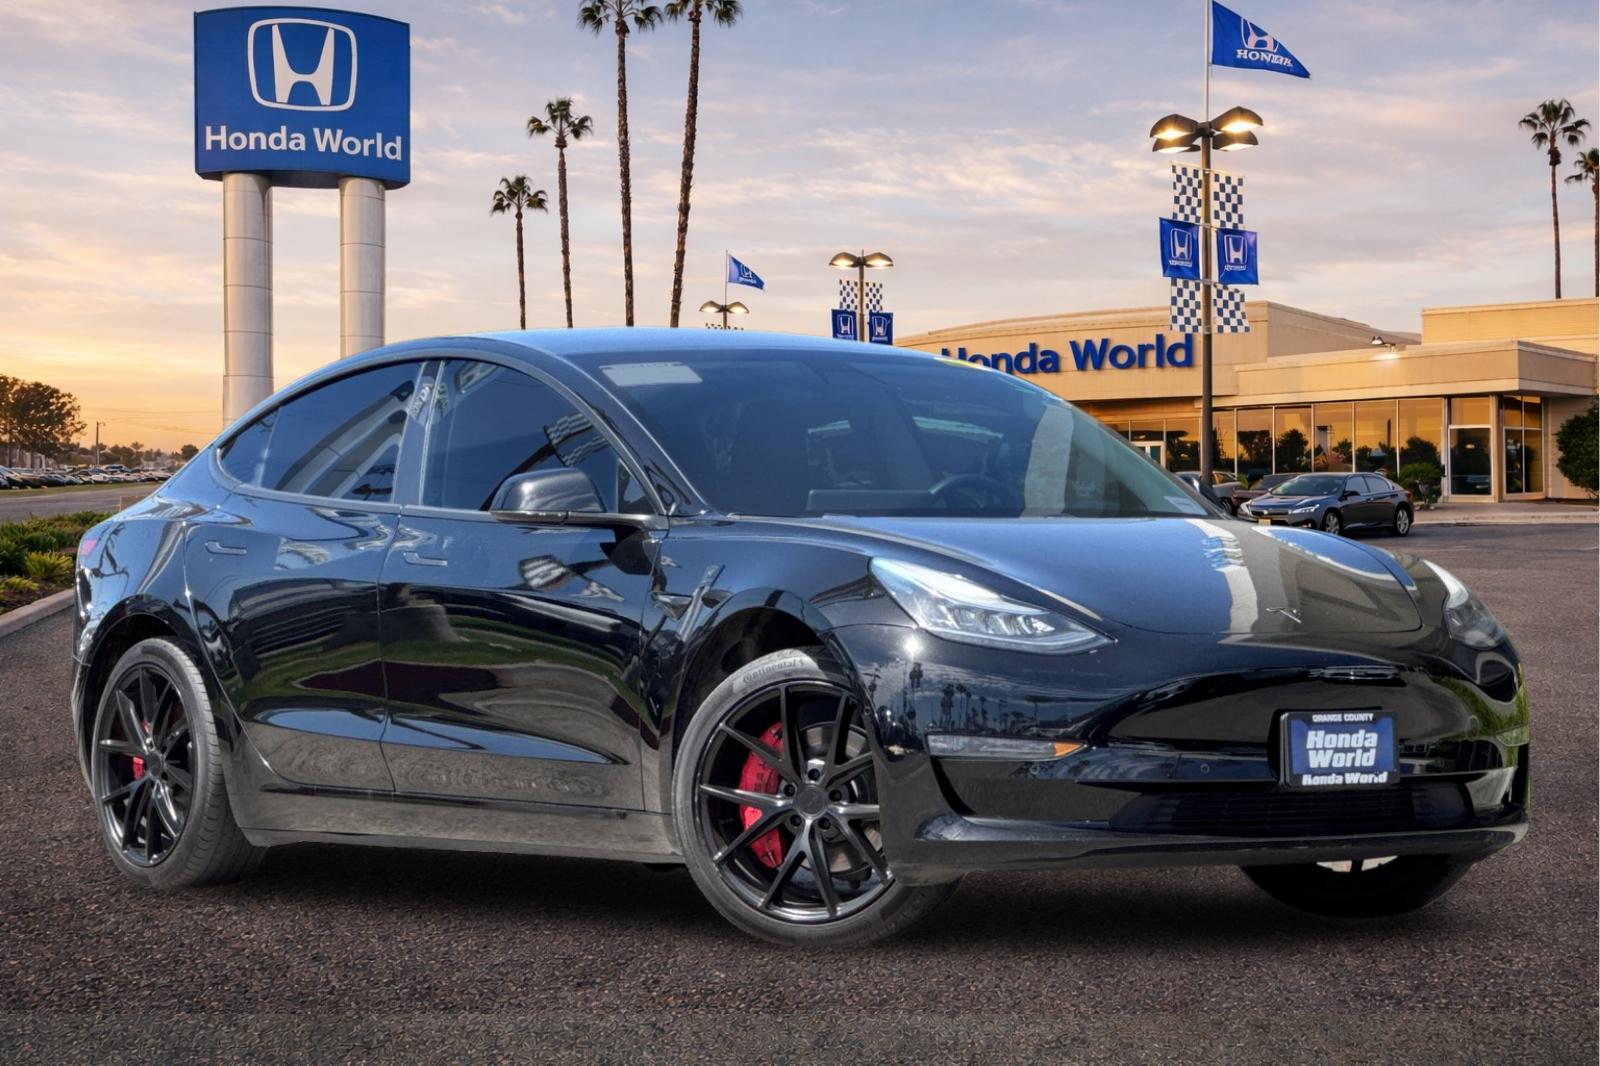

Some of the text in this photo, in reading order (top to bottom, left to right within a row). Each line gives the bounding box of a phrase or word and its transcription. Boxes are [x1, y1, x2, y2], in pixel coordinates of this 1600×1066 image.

[205, 125, 402, 160] Honda World
[1069, 333, 1194, 371] World
[1312, 713, 1374, 722] ORANGE COUNTY
[1306, 729, 1378, 749] Honda
[1308, 748, 1376, 768] World
[1302, 773, 1343, 786] Honda
